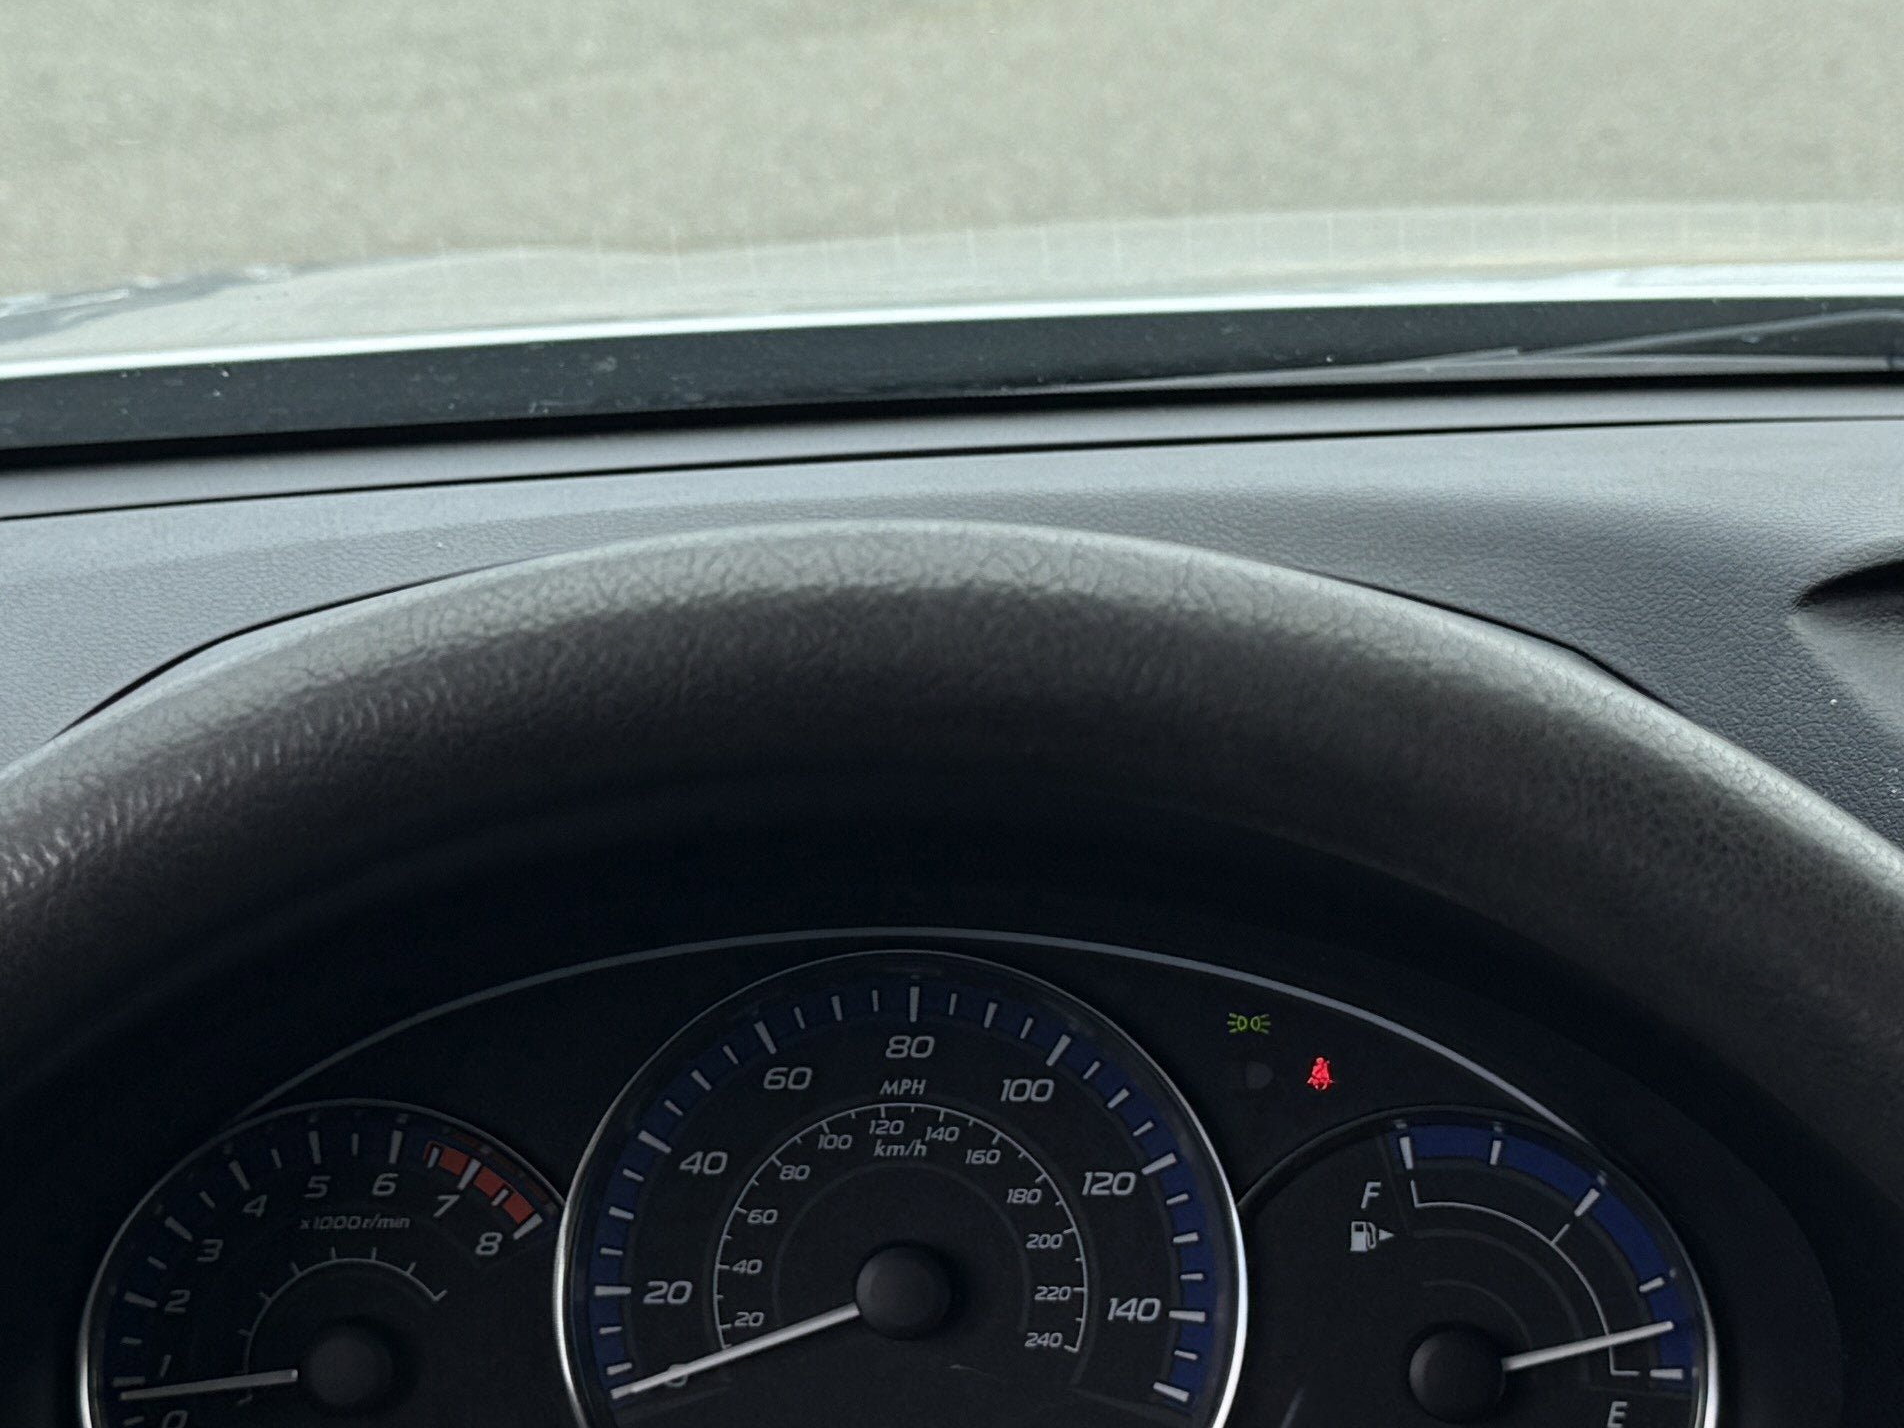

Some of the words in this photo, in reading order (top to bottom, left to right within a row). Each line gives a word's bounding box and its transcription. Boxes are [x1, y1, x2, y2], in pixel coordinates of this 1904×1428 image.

[886, 1036, 935, 1058] 80
[764, 1067, 812, 1090] 60
[880, 1079, 926, 1095] MPH
[1001, 1079, 1054, 1102] 100
[869, 1120, 904, 1135] 120
[925, 1126, 959, 1141] 140
[818, 1133, 853, 1149] 100
[873, 1137, 928, 1157] km/h
[680, 1152, 727, 1175] 40
[966, 1149, 1001, 1164] 160
[778, 1164, 810, 1180] 80
[304, 1176, 331, 1198] 5
[372, 1173, 398, 1196] 6
[1083, 1172, 1136, 1195] 120
[242, 1195, 267, 1217] 4
[434, 1195, 460, 1217] 7
[1007, 1189, 1042, 1204] 180
[1361, 1182, 1381, 1209] F
[746, 1209, 778, 1224] 60
[197, 1239, 223, 1262] 3
[475, 1232, 502, 1255] 8
[1026, 1233, 1063, 1249] 200
[731, 1259, 762, 1274] 40
[164, 1290, 190, 1312] 2
[643, 1281, 692, 1304] 20
[1035, 1286, 1070, 1301] 220
[734, 1312, 764, 1327] 20
[1108, 1298, 1160, 1321] 140
[1025, 1332, 1062, 1347] 240
[160, 1355, 171, 1377] 1
[1607, 1401, 1627, 1428] E
